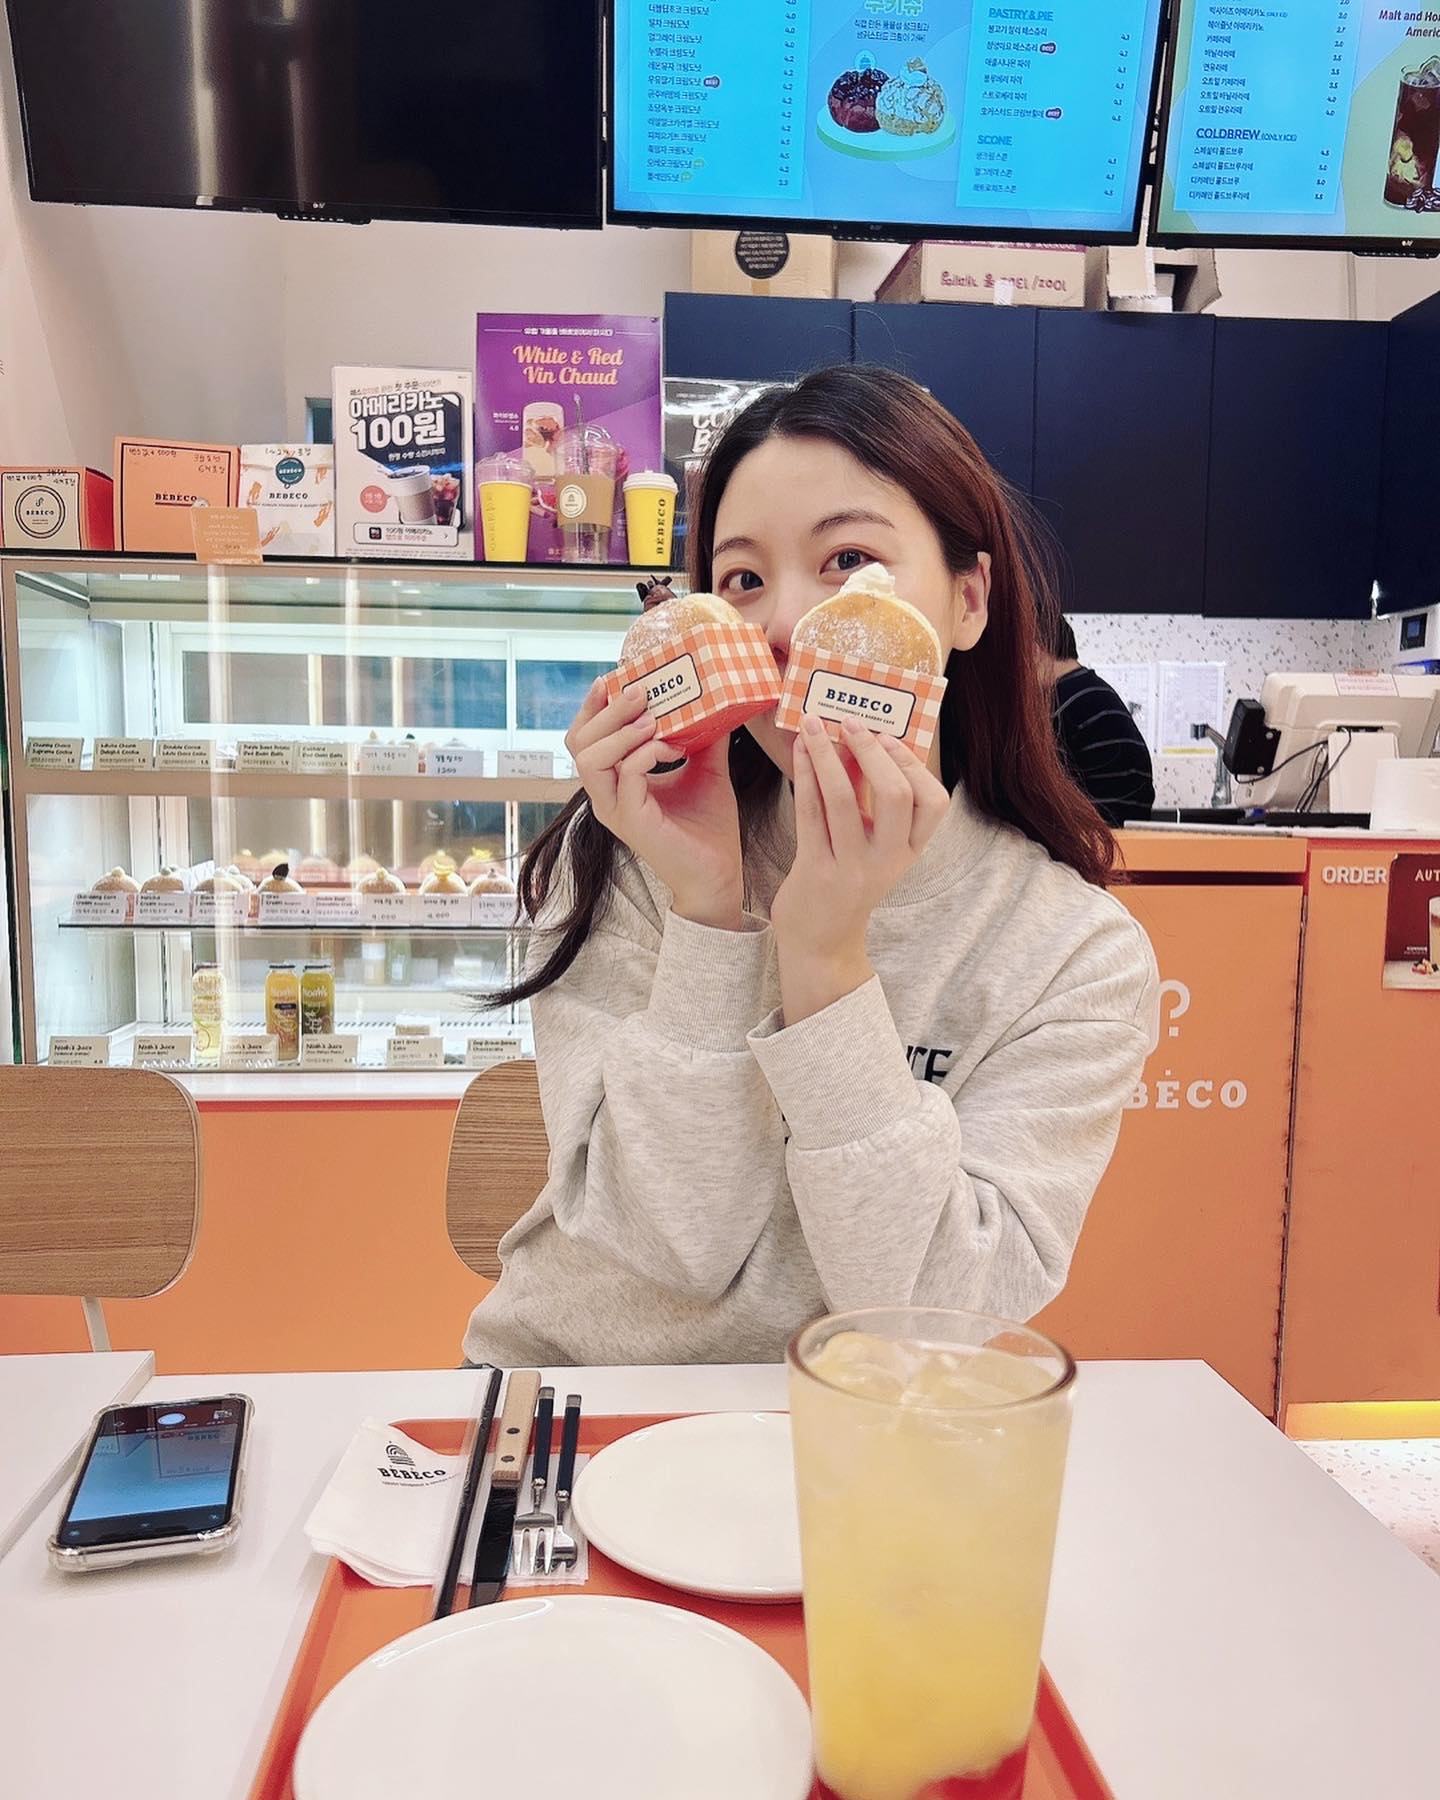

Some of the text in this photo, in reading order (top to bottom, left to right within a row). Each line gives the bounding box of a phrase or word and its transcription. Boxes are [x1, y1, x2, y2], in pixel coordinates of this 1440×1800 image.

[988, 8, 1028, 20] PASTRY
[1038, 11, 1054, 21] PIE
[1378, 9, 1402, 21] Malt
[1403, 10, 1422, 21] and
[976, 134, 1013, 146] SCONE
[1196, 128, 1261, 140] COLDBREW
[512, 345, 625, 366] White & Red
[522, 365, 620, 386] Vin Chaud
[350, 391, 444, 418] 아메리카노
[350, 409, 446, 451] 100원
[1322, 866, 1388, 885] ORDER
